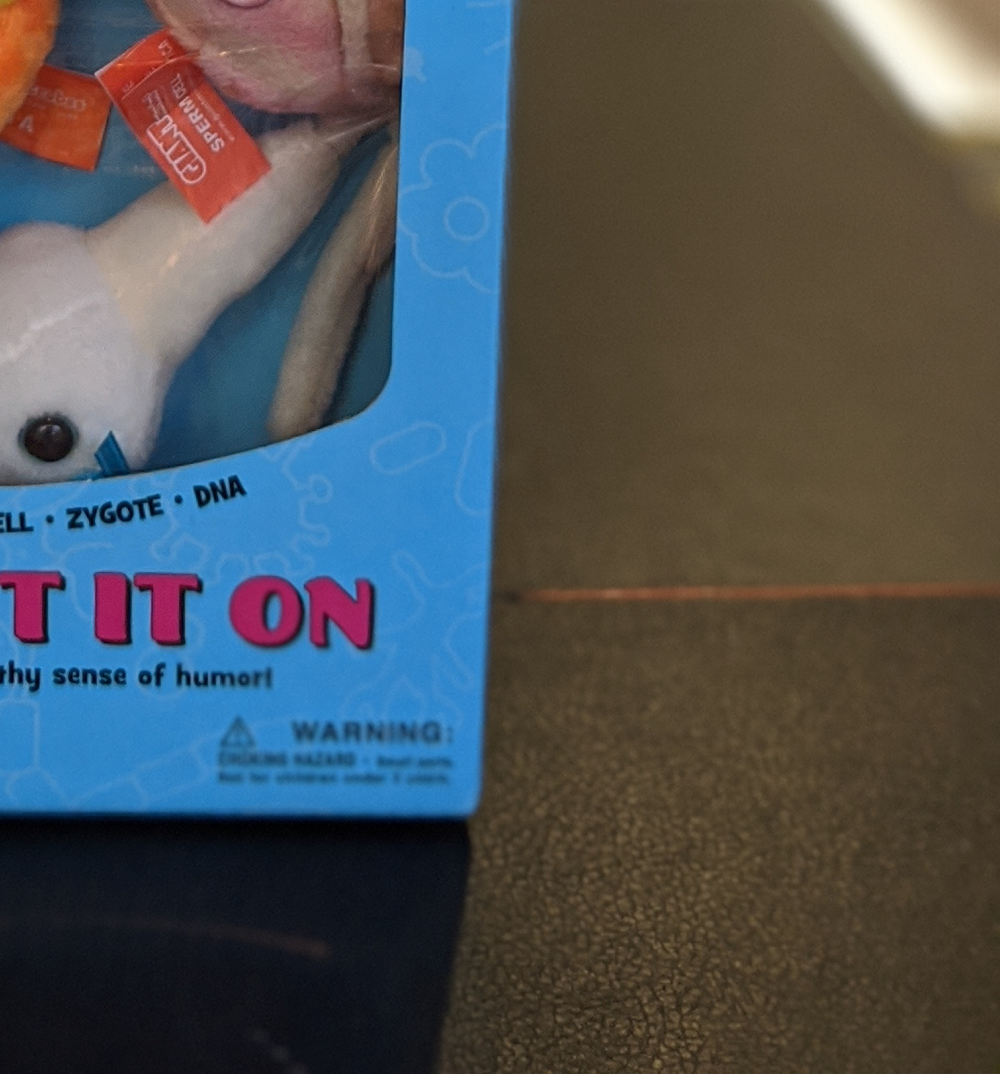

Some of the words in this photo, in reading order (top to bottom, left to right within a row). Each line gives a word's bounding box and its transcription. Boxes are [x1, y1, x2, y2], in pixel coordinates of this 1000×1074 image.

[146, 114, 207, 184] GIANT
[179, 98, 226, 154] SPERM
[66, 493, 165, 530] ZYGOTE
[193, 475, 247, 508] DNA
[94, 571, 203, 646] IT
[228, 575, 376, 650] ON
[52, 666, 127, 685] sense
[137, 662, 167, 686] of
[176, 662, 273, 688] humor!
[290, 721, 453, 744] WARNING:
